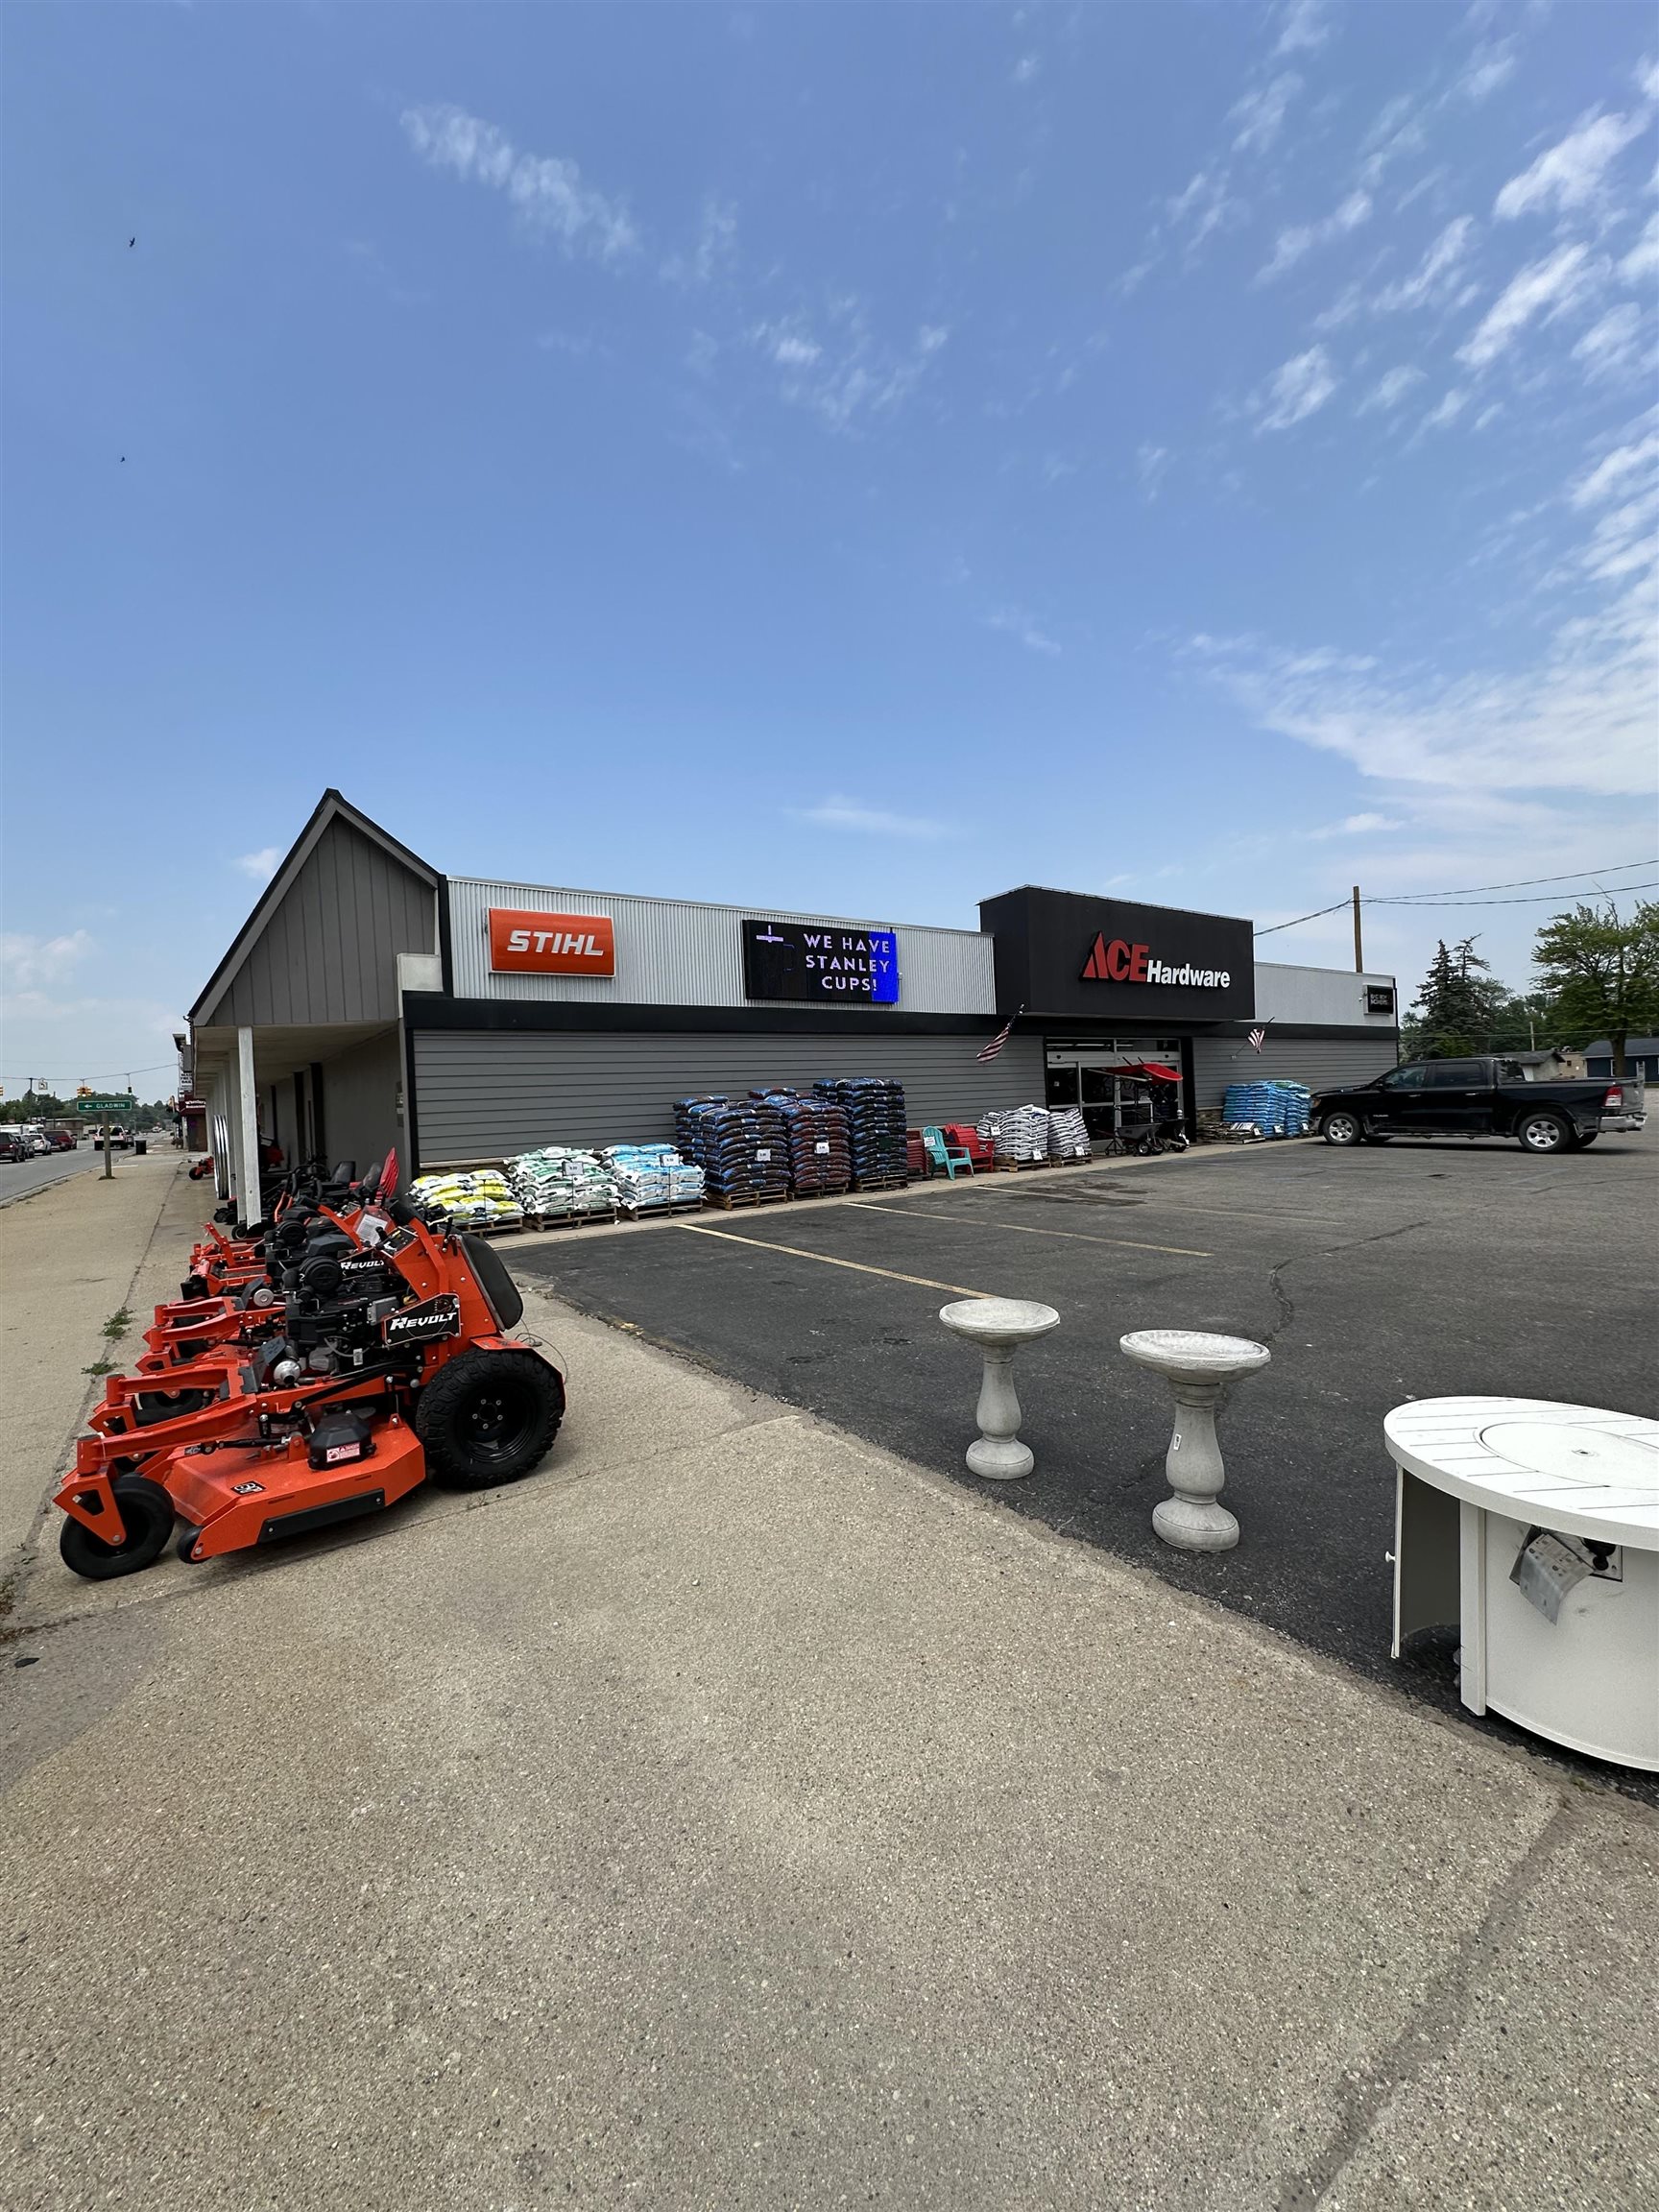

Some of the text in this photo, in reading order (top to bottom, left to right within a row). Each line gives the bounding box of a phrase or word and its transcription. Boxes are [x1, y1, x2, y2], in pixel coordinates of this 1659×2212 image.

[507, 929, 604, 956] STIHL
[803, 933, 890, 953] WE HAVE
[805, 954, 890, 974] STANLEY
[1082, 930, 1231, 988] ACE Hardware
[821, 975, 878, 992] CUPS!
